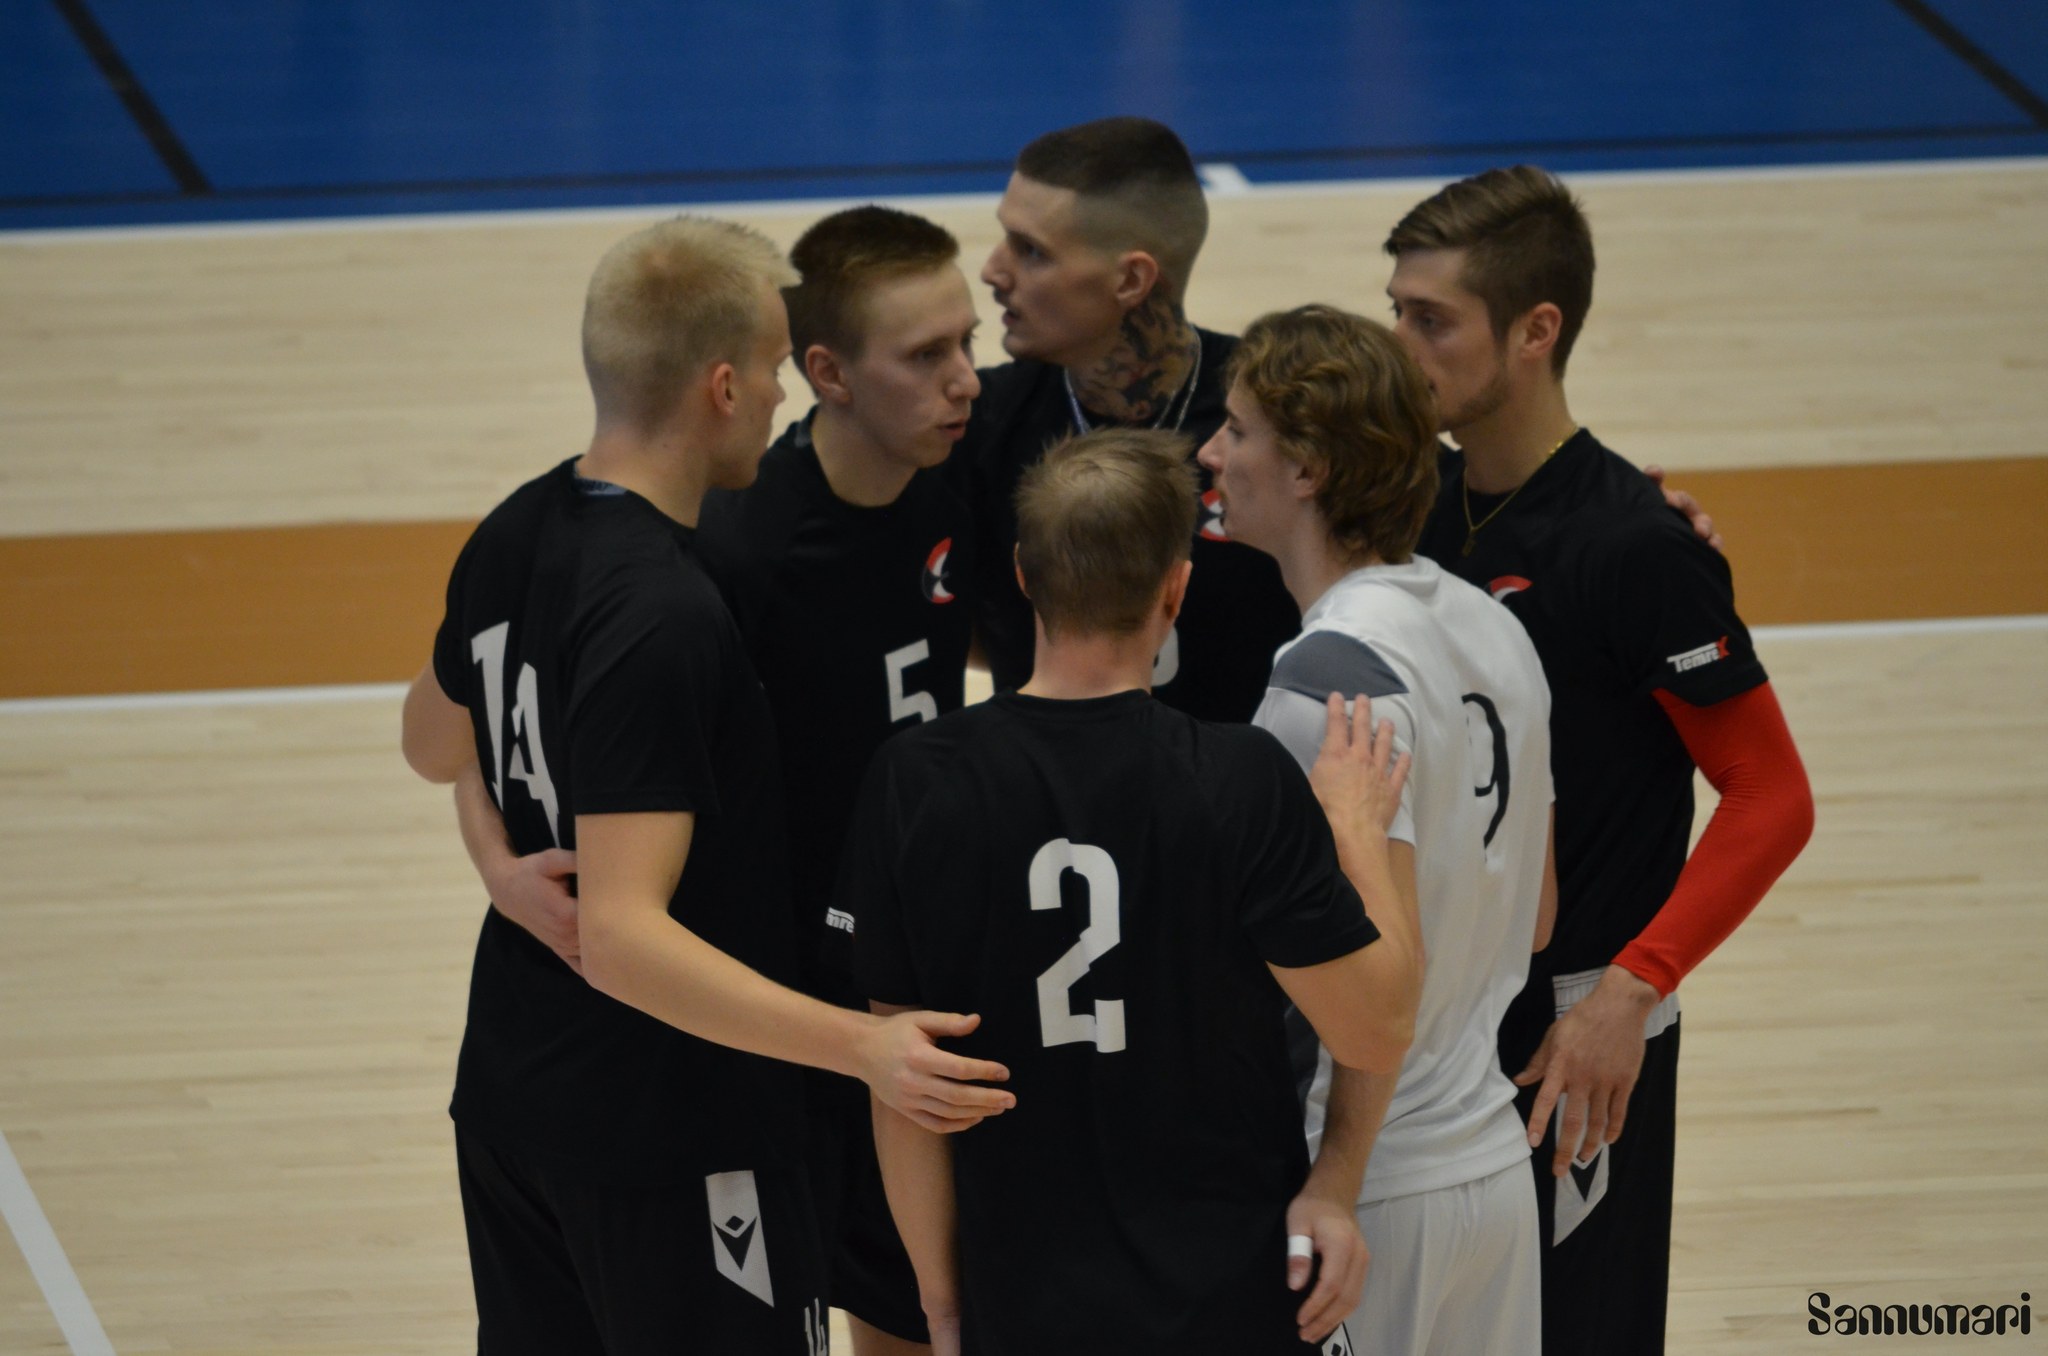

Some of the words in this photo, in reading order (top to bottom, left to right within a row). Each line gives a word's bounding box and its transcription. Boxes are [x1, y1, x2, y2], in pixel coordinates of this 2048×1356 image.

[470, 620, 561, 849] 14
[885, 638, 938, 723] 5
[1028, 837, 1126, 1053] 2
